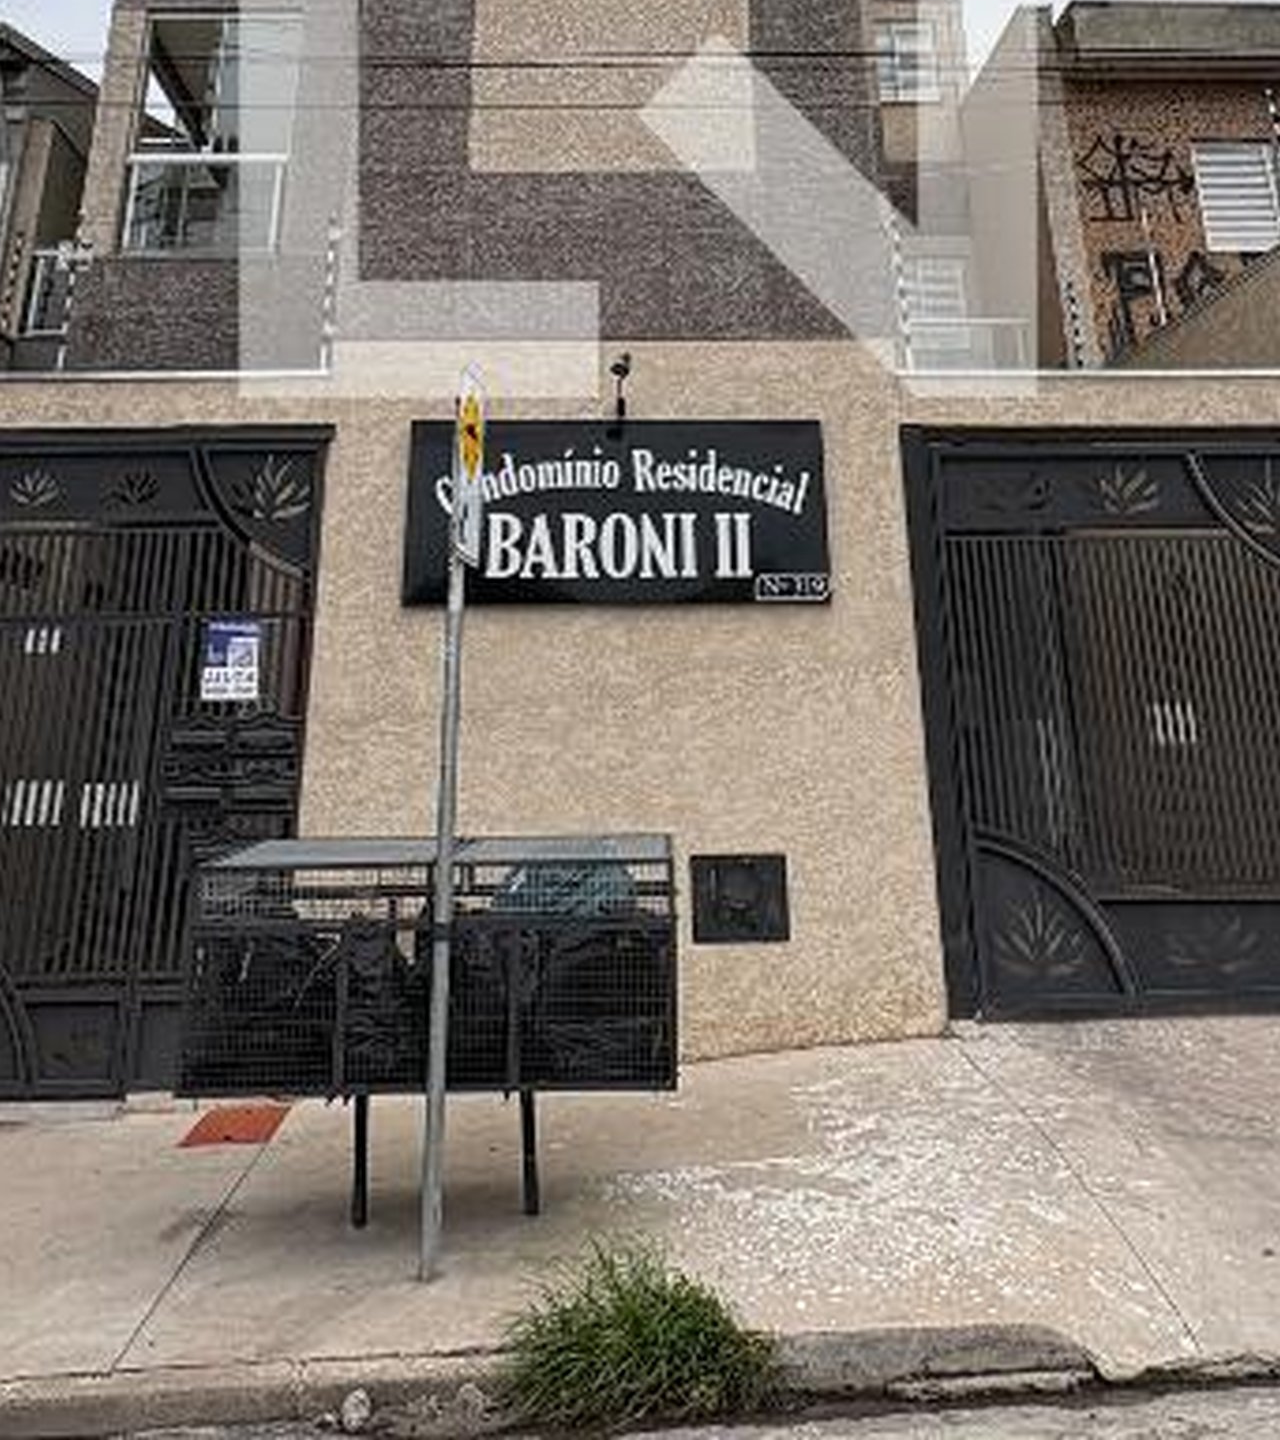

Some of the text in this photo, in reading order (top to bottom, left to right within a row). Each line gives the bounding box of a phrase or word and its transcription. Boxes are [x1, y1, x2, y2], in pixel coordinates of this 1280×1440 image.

[435, 448, 811, 515] Cndomínio Residencial
[485, 512, 754, 580] BARONI II
